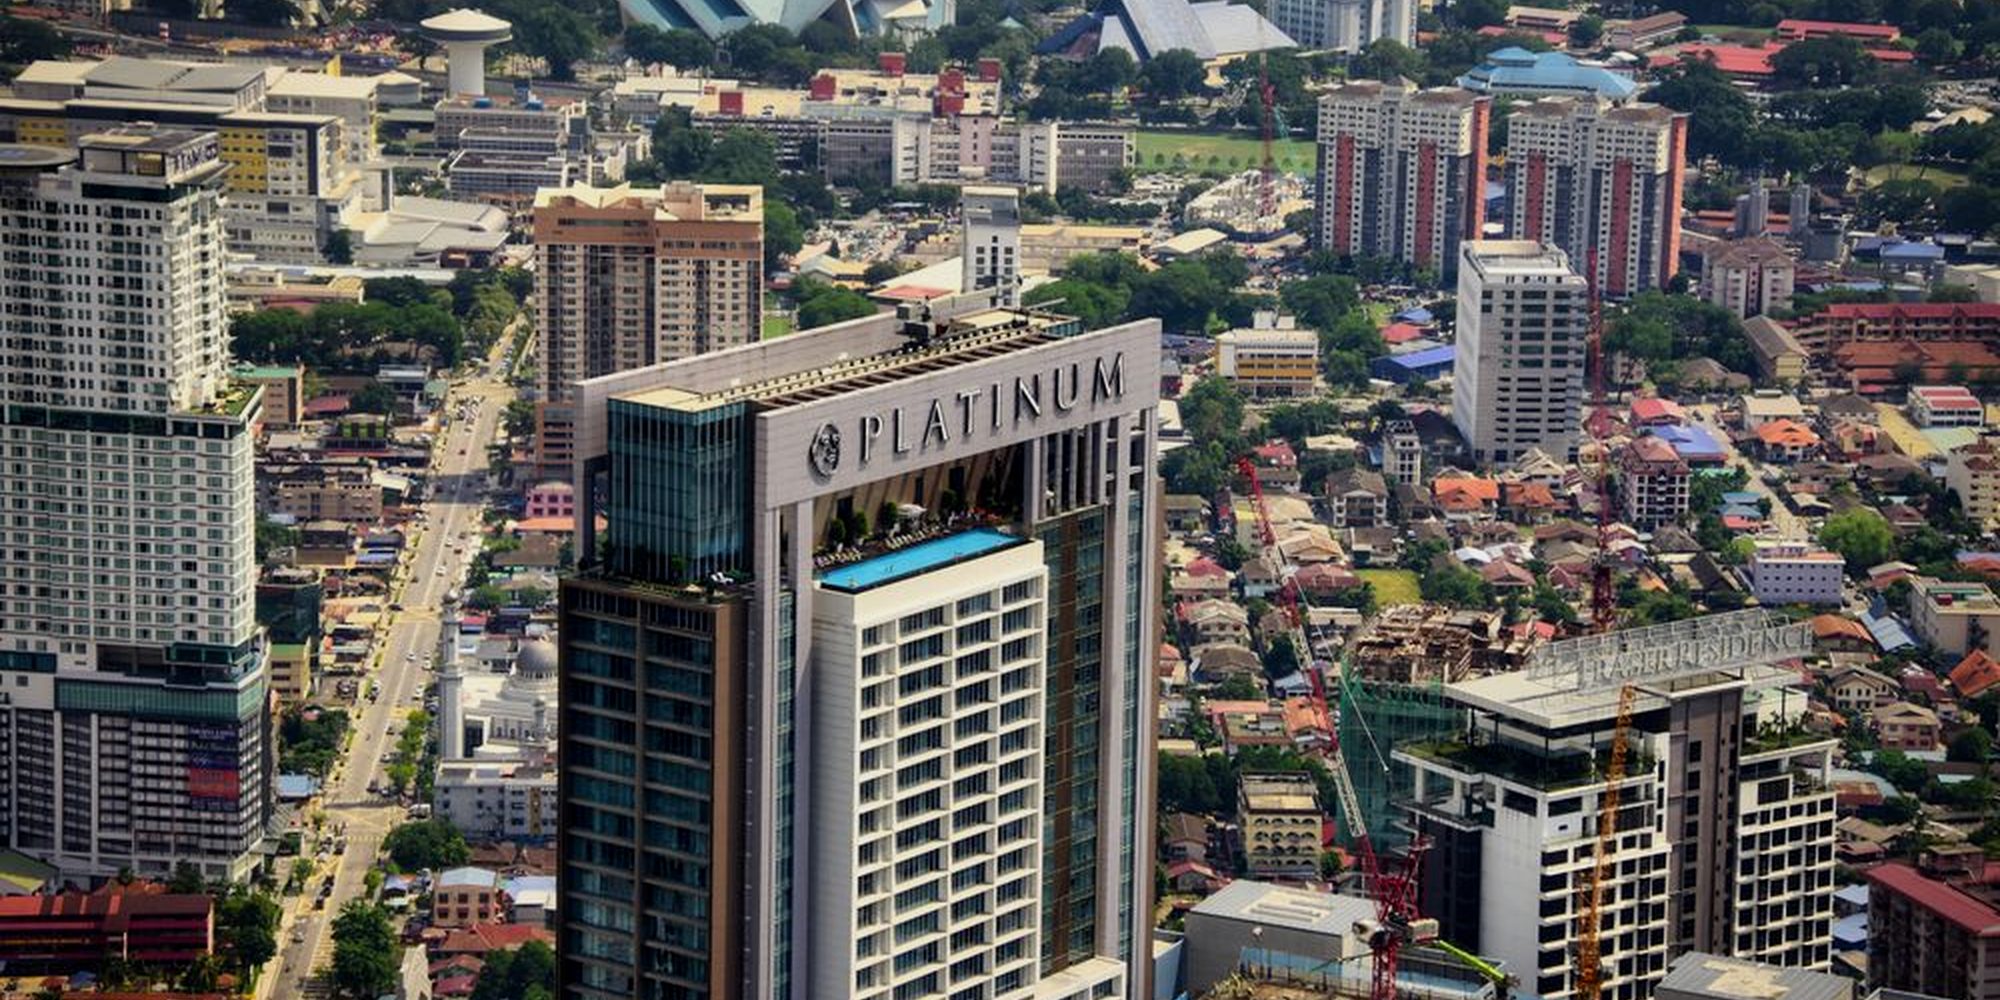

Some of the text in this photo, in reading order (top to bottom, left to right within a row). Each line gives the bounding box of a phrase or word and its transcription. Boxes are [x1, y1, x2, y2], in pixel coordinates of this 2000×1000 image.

[861, 352, 1126, 462] PLATINUM
[1582, 621, 1815, 682] FRASER RESIDENCE
